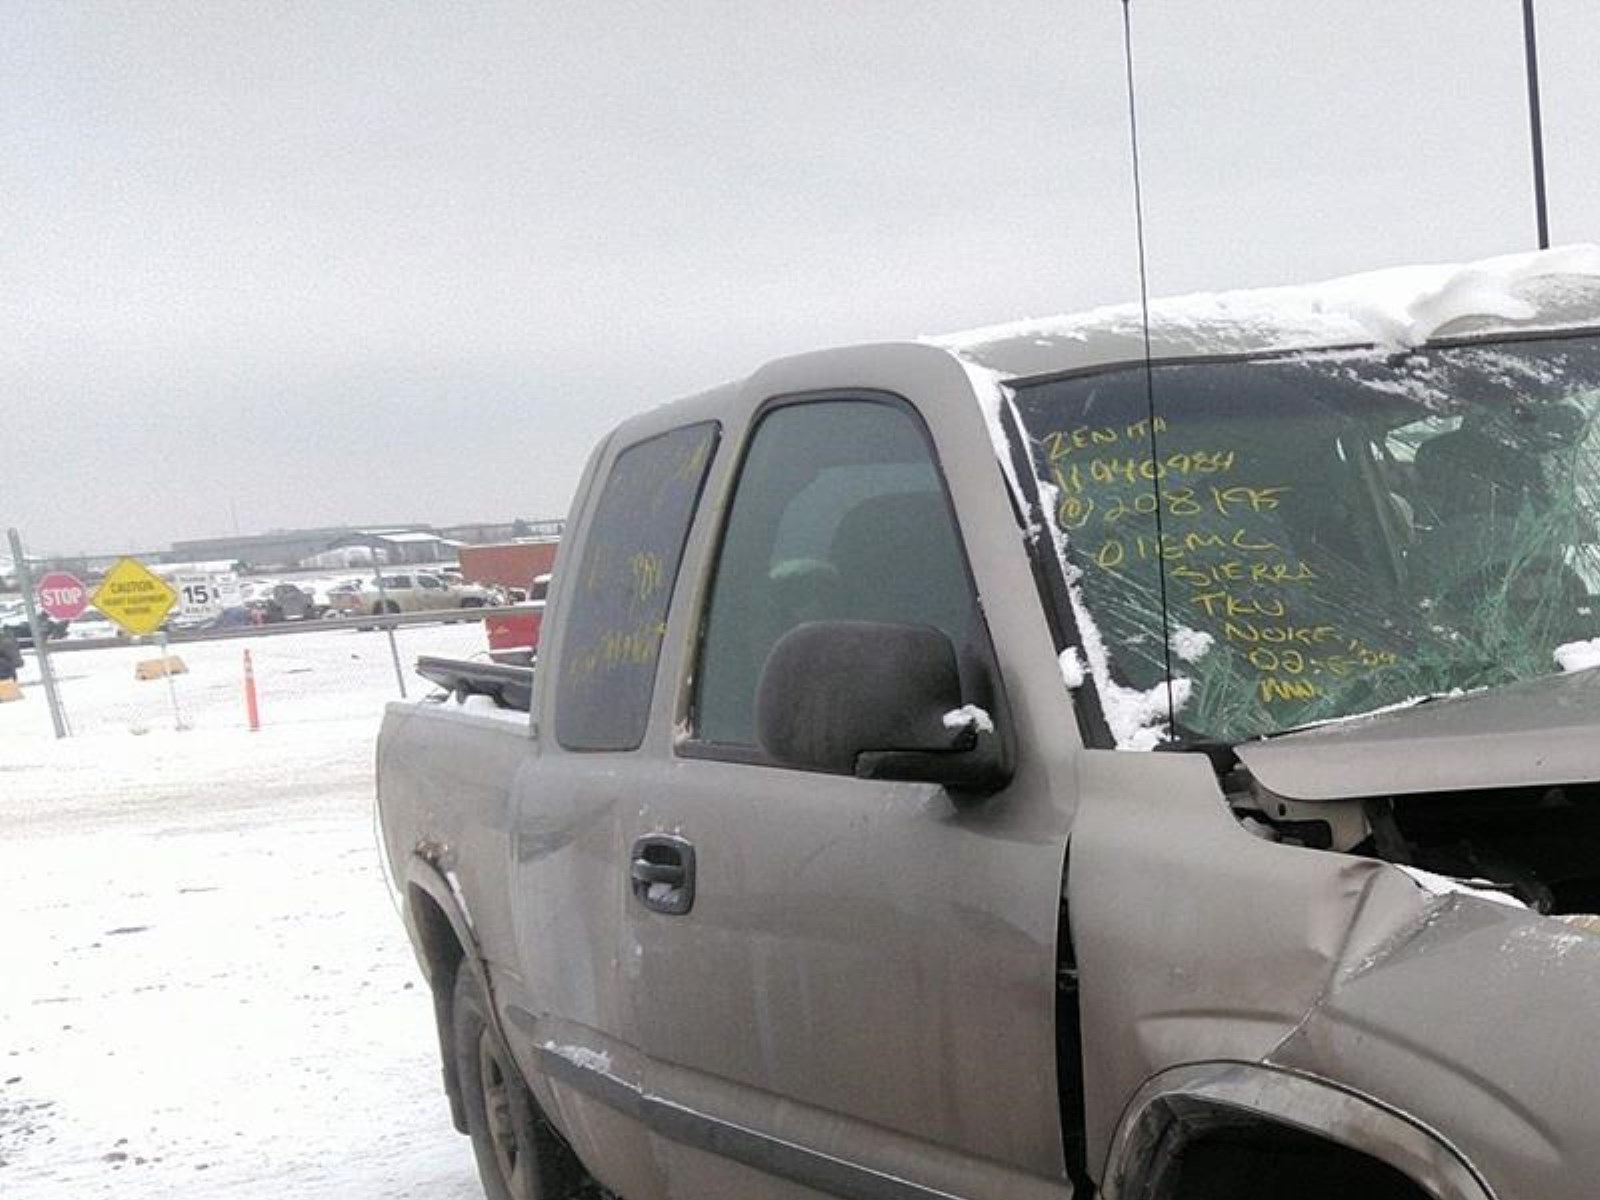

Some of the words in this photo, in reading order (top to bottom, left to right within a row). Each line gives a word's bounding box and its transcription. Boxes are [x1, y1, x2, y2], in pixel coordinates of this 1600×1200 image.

[1054, 451, 1234, 494] 11940984
[1170, 561, 1317, 586] SIERRA
[41, 586, 82, 607] STOP
[181, 585, 209, 604] 15
